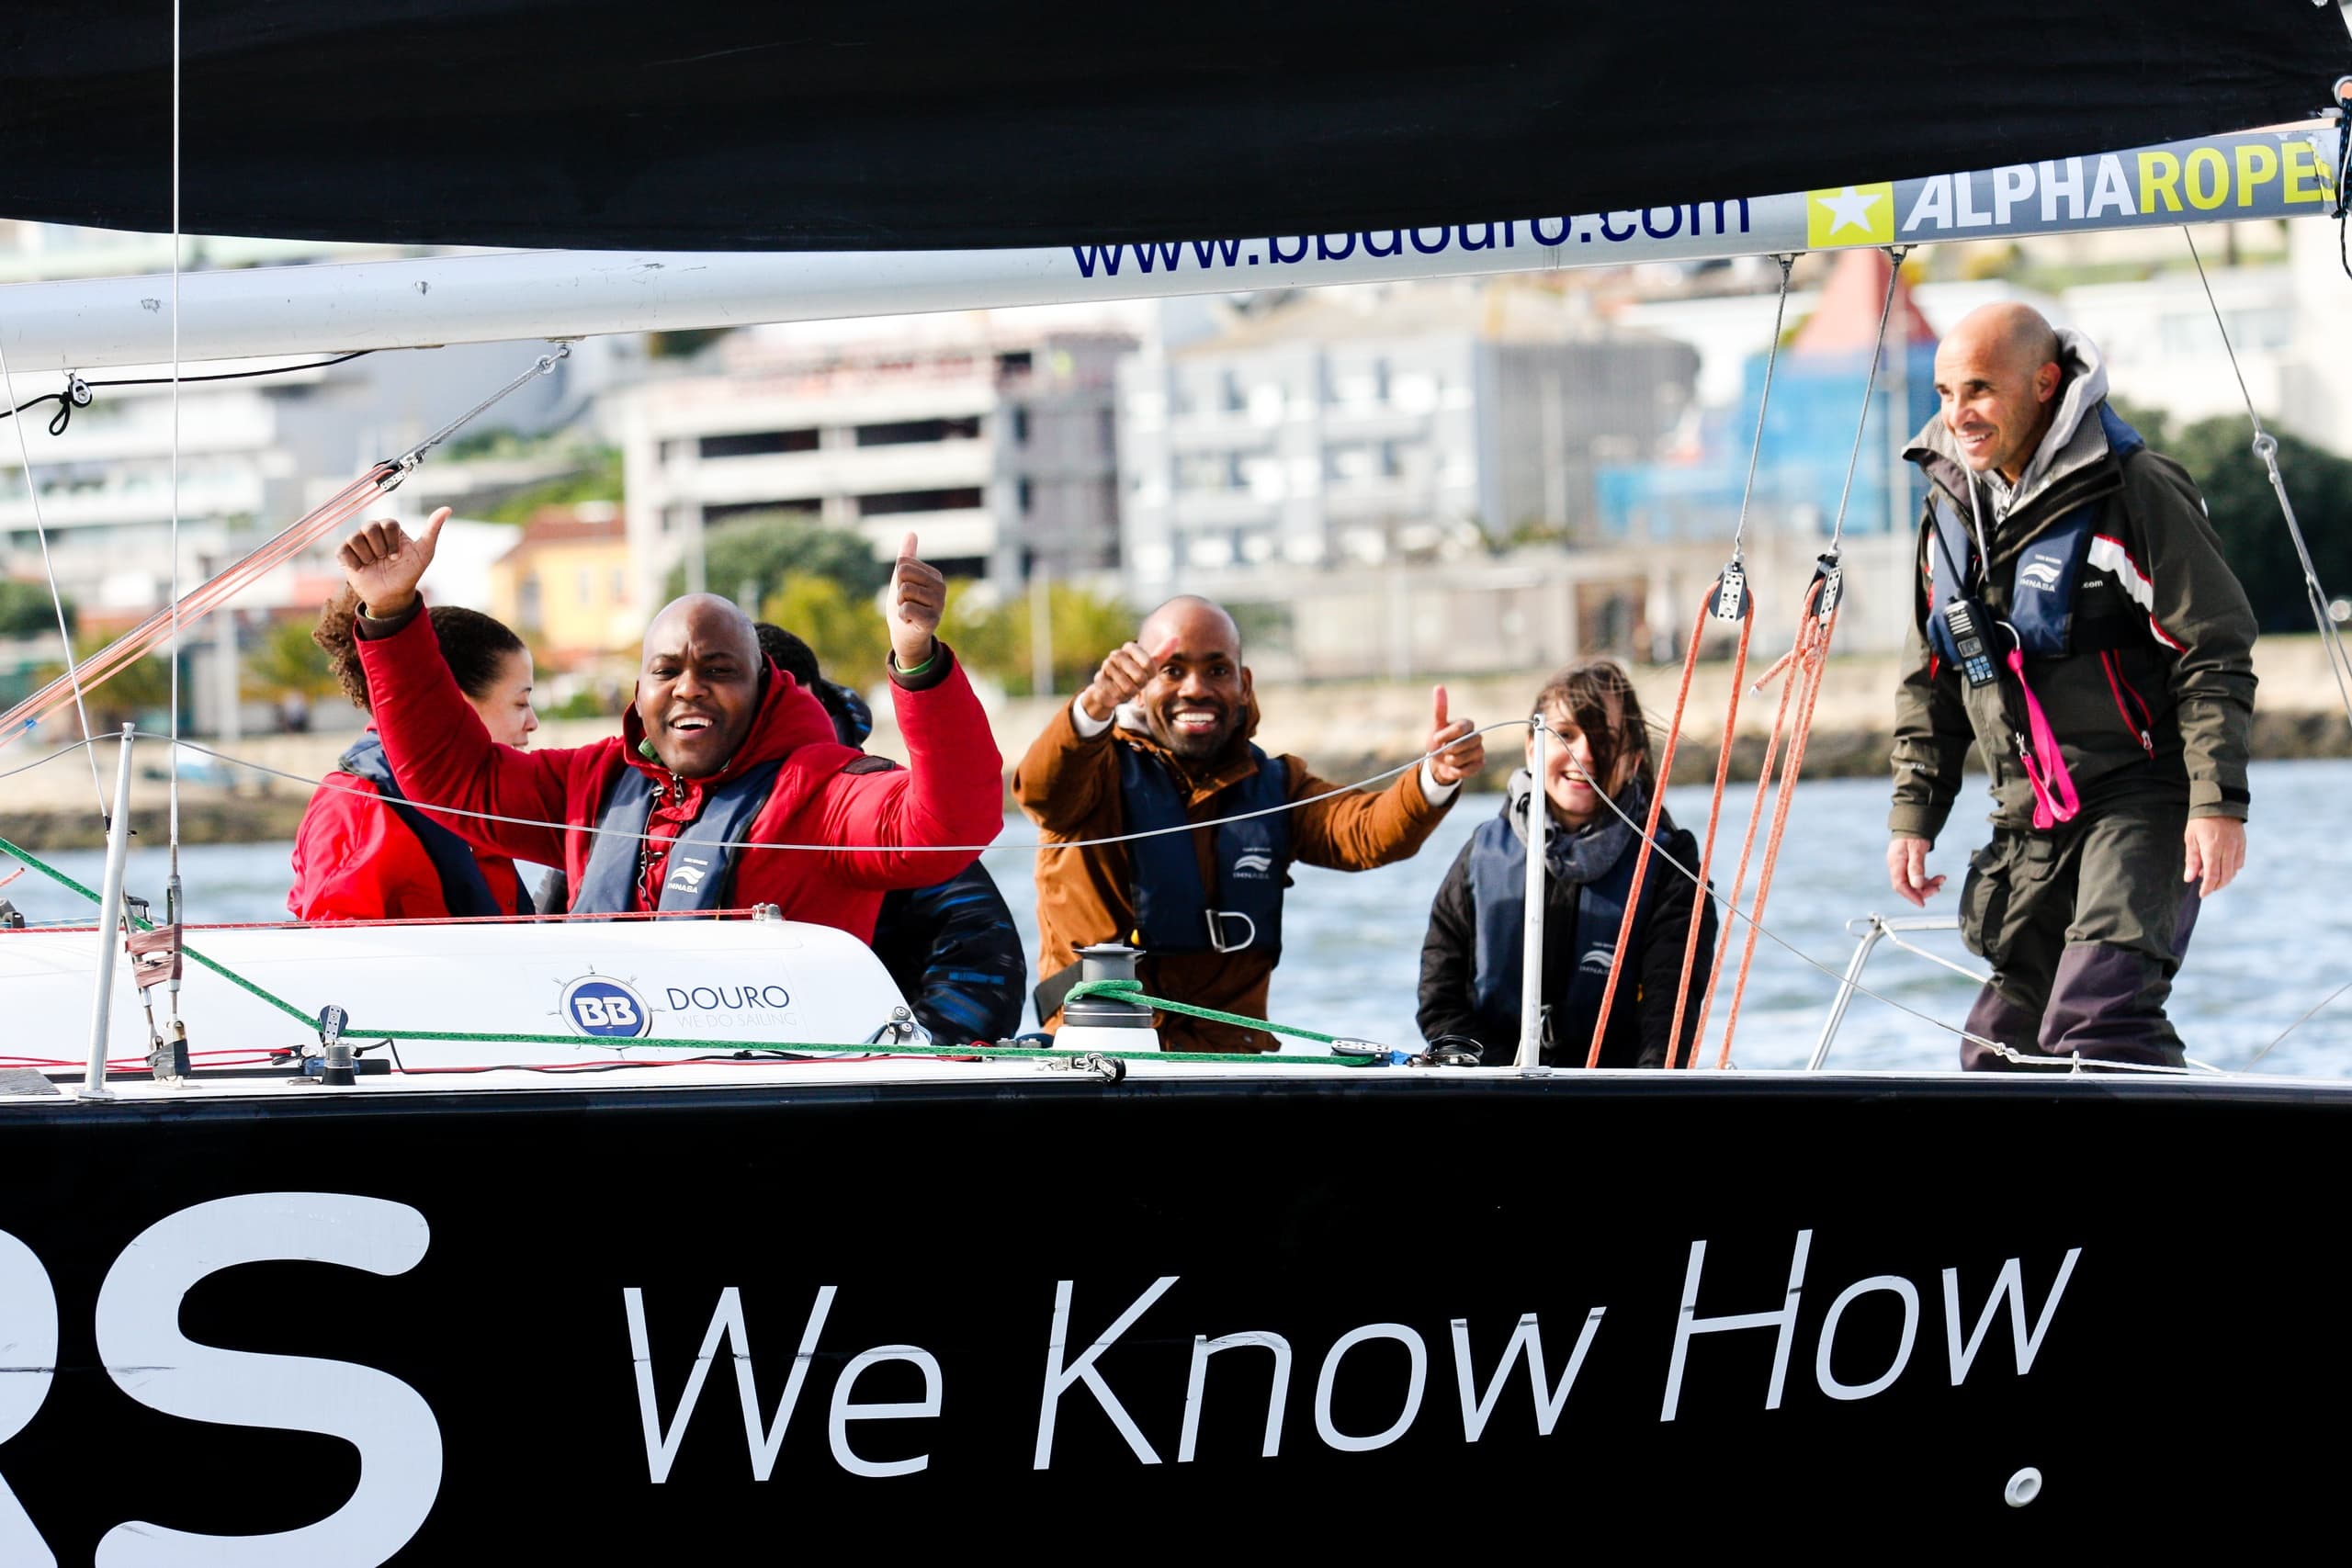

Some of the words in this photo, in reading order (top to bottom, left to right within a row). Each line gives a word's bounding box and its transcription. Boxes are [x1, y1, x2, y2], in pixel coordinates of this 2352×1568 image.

[575, 997, 638, 1027] BB
[666, 985, 790, 1010] DOURO
[706, 1013, 733, 1028] DO
[623, 1285, 943, 1484] We
[1033, 1275, 1608, 1471] Know
[1659, 1228, 2083, 1422] How
